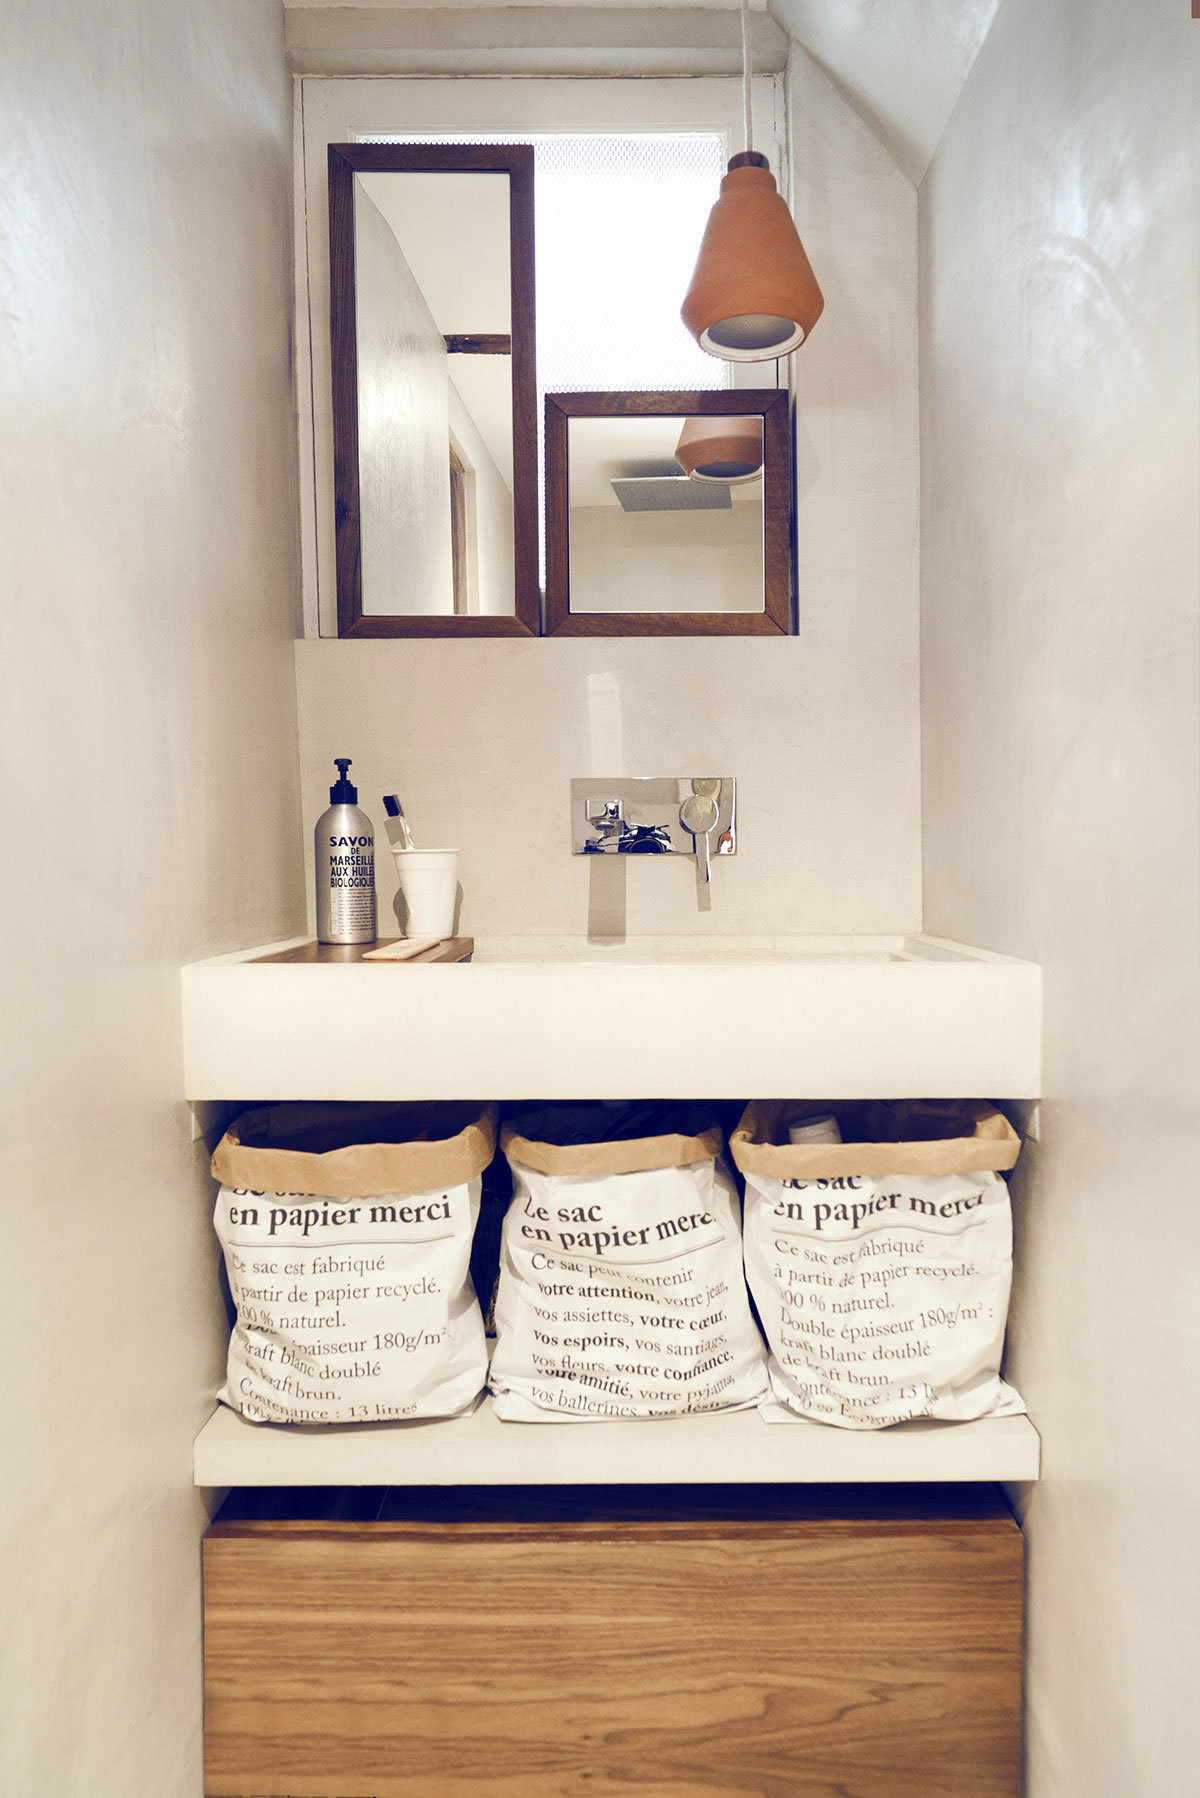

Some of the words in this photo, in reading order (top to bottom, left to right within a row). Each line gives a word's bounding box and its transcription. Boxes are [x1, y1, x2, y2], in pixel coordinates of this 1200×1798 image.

[330, 836, 374, 847] SAVON
[351, 847, 360, 855] DE
[330, 856, 374, 866] MARSEILLE
[330, 867, 348, 877] AUX
[816, 1176, 863, 1190] sac
[229, 1206, 259, 1226] en
[267, 1201, 361, 1236] papier
[369, 1194, 452, 1223] merci
[524, 1195, 550, 1221] Le
[557, 1205, 603, 1223] sac
[774, 1201, 804, 1221] en
[814, 1194, 902, 1231] papier
[521, 1225, 553, 1242] en
[558, 1226, 650, 1256] papier
[655, 1211, 717, 1241] merc
[531, 1253, 555, 1270] Ce
[560, 1261, 584, 1273] sac
[774, 1239, 799, 1256] Ce
[804, 1249, 828, 1264] sac
[832, 1252, 856, 1266] est
[252, 1263, 279, 1274] sac
[284, 1263, 305, 1275] est
[311, 1255, 385, 1278] fabriqué
[774, 1263, 782, 1278] à
[789, 1270, 834, 1287] partir
[839, 1273, 854, 1288] de
[860, 1264, 909, 1289] papier
[915, 1263, 979, 1281] recyclé.
[241, 1285, 283, 1302] partir
[287, 1285, 312, 1302] de
[315, 1283, 370, 1307] papier
[376, 1277, 441, 1302] recyclé.
[538, 1283, 574, 1296] votre
[578, 1285, 661, 1304] attention,
[664, 1293, 703, 1308] votre
[705, 1281, 729, 1308] jean,
[781, 1289, 804, 1309] 00
[810, 1294, 826, 1312] %
[832, 1292, 895, 1314] naturel.
[260, 1309, 274, 1328] %
[279, 1310, 346, 1329] naturel.
[534, 1306, 558, 1322] vos
[563, 1308, 634, 1326] assiettes,
[639, 1314, 685, 1329] votre
[780, 1306, 836, 1338] Double
[841, 1319, 914, 1344] épaisseur
[292, 1339, 367, 1357] paisseur
[533, 1329, 559, 1346] vos
[563, 1332, 630, 1352] espoirs,
[635, 1338, 661, 1353] vos
[820, 1344, 867, 1362] blanc
[872, 1341, 931, 1360] doublé
[281, 1346, 315, 1378] blanc
[319, 1360, 381, 1380] doublé
[532, 1353, 556, 1367] vos
[614, 1364, 659, 1378] votre
[663, 1350, 734, 1381] confiance,
[782, 1354, 801, 1366] de
[848, 1371, 894, 1386] brun.
[295, 1382, 341, 1400] brun.
[531, 1386, 555, 1404] vos
[579, 1375, 634, 1399] amitié,
[639, 1390, 682, 1401] votre
[348, 1405, 369, 1417] 13
